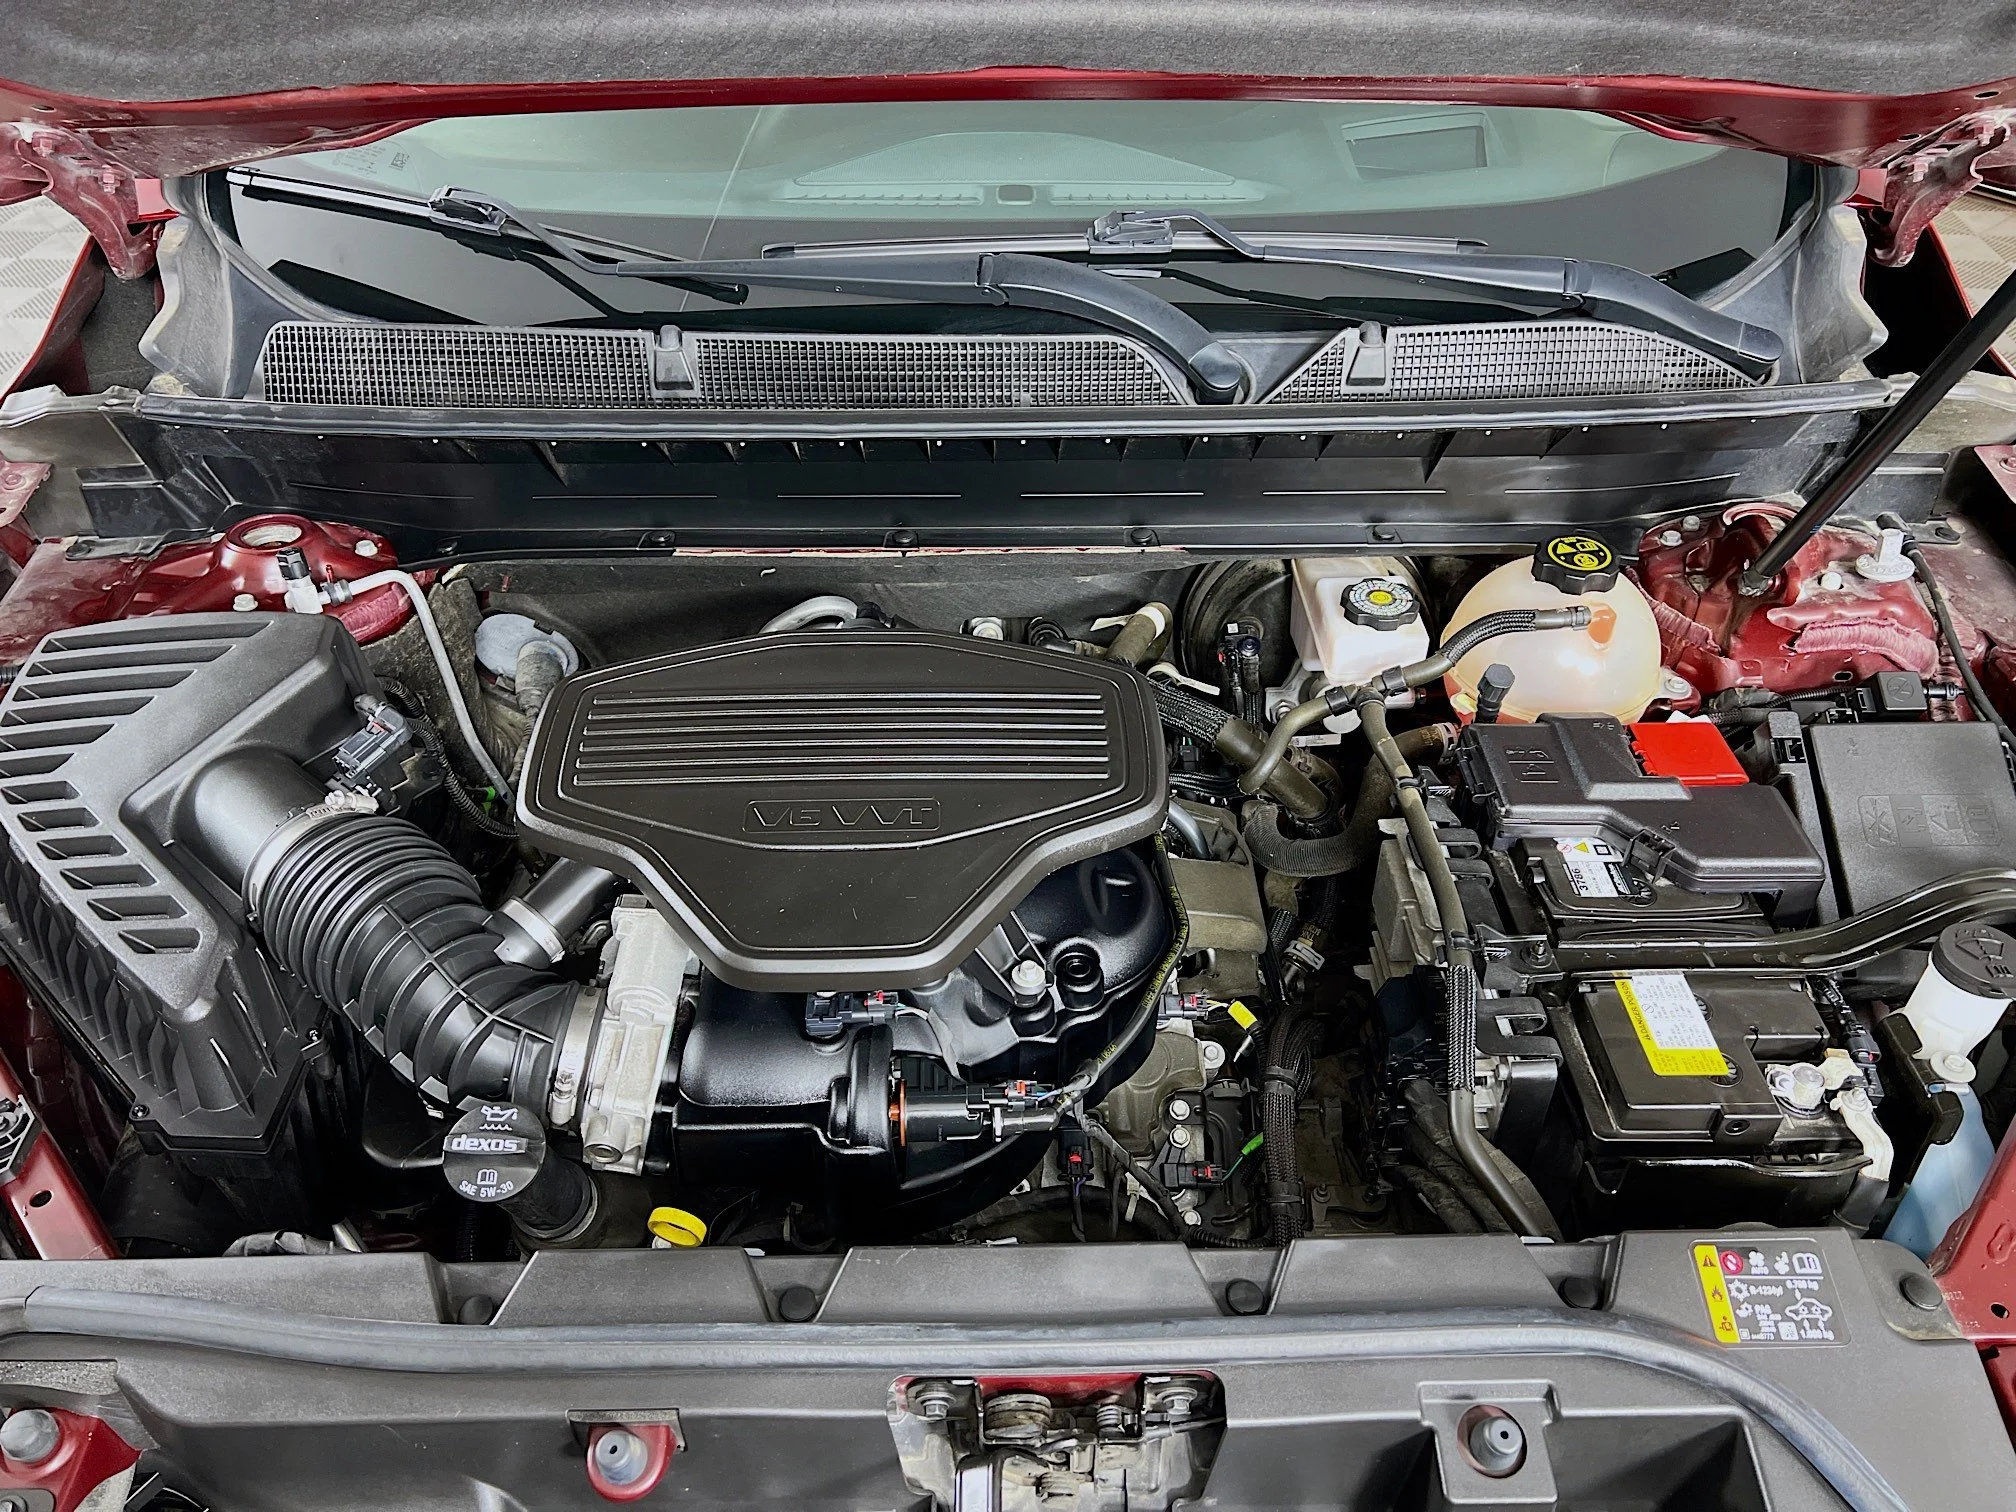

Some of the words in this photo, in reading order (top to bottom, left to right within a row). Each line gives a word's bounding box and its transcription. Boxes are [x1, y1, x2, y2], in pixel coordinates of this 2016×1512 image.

[832, 804, 933, 825] VVT
[1572, 868, 1589, 891] 3786
[451, 1133, 519, 1152] dexos
[459, 1180, 476, 1196] SAE
[479, 1180, 514, 1198] 5W-30
